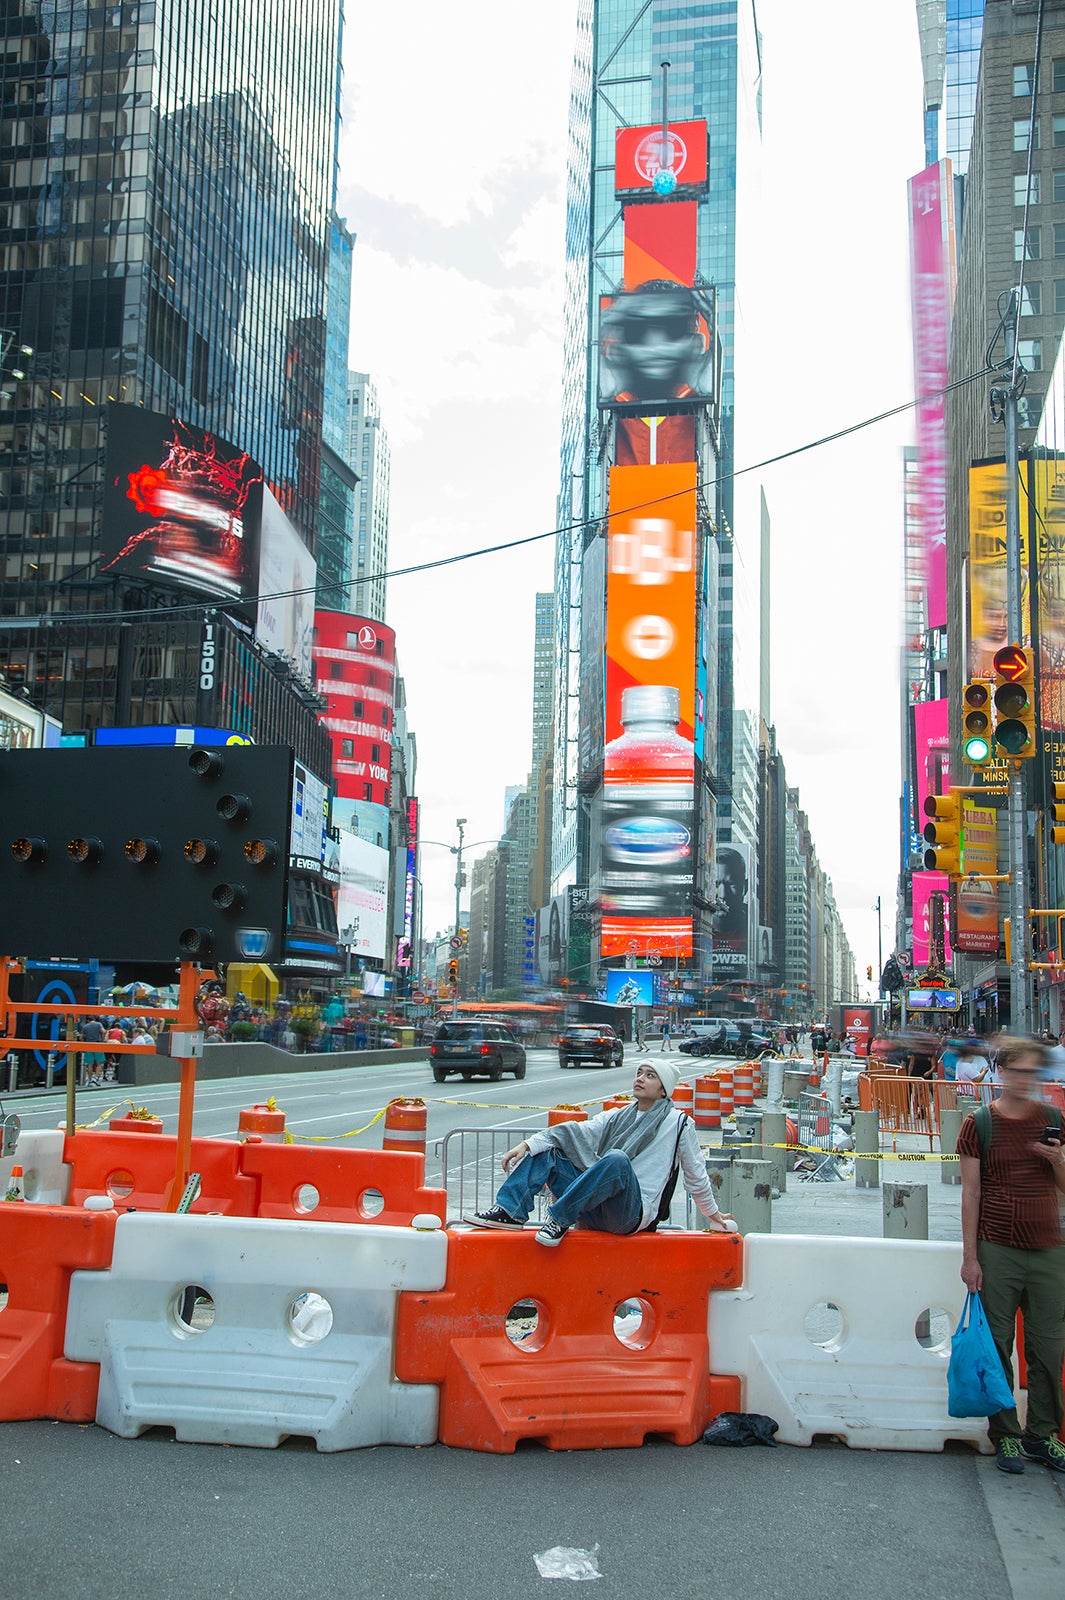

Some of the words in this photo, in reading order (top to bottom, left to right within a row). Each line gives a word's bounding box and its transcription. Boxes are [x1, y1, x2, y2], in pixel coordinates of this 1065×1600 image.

[200, 624, 215, 690] 1500
[368, 763, 389, 783] YORK
[982, 771, 1008, 782] MINSK
[959, 932, 996, 941] RESTAURANT
[965, 941, 990, 949] MARKET
[711, 953, 747, 965] OWER
